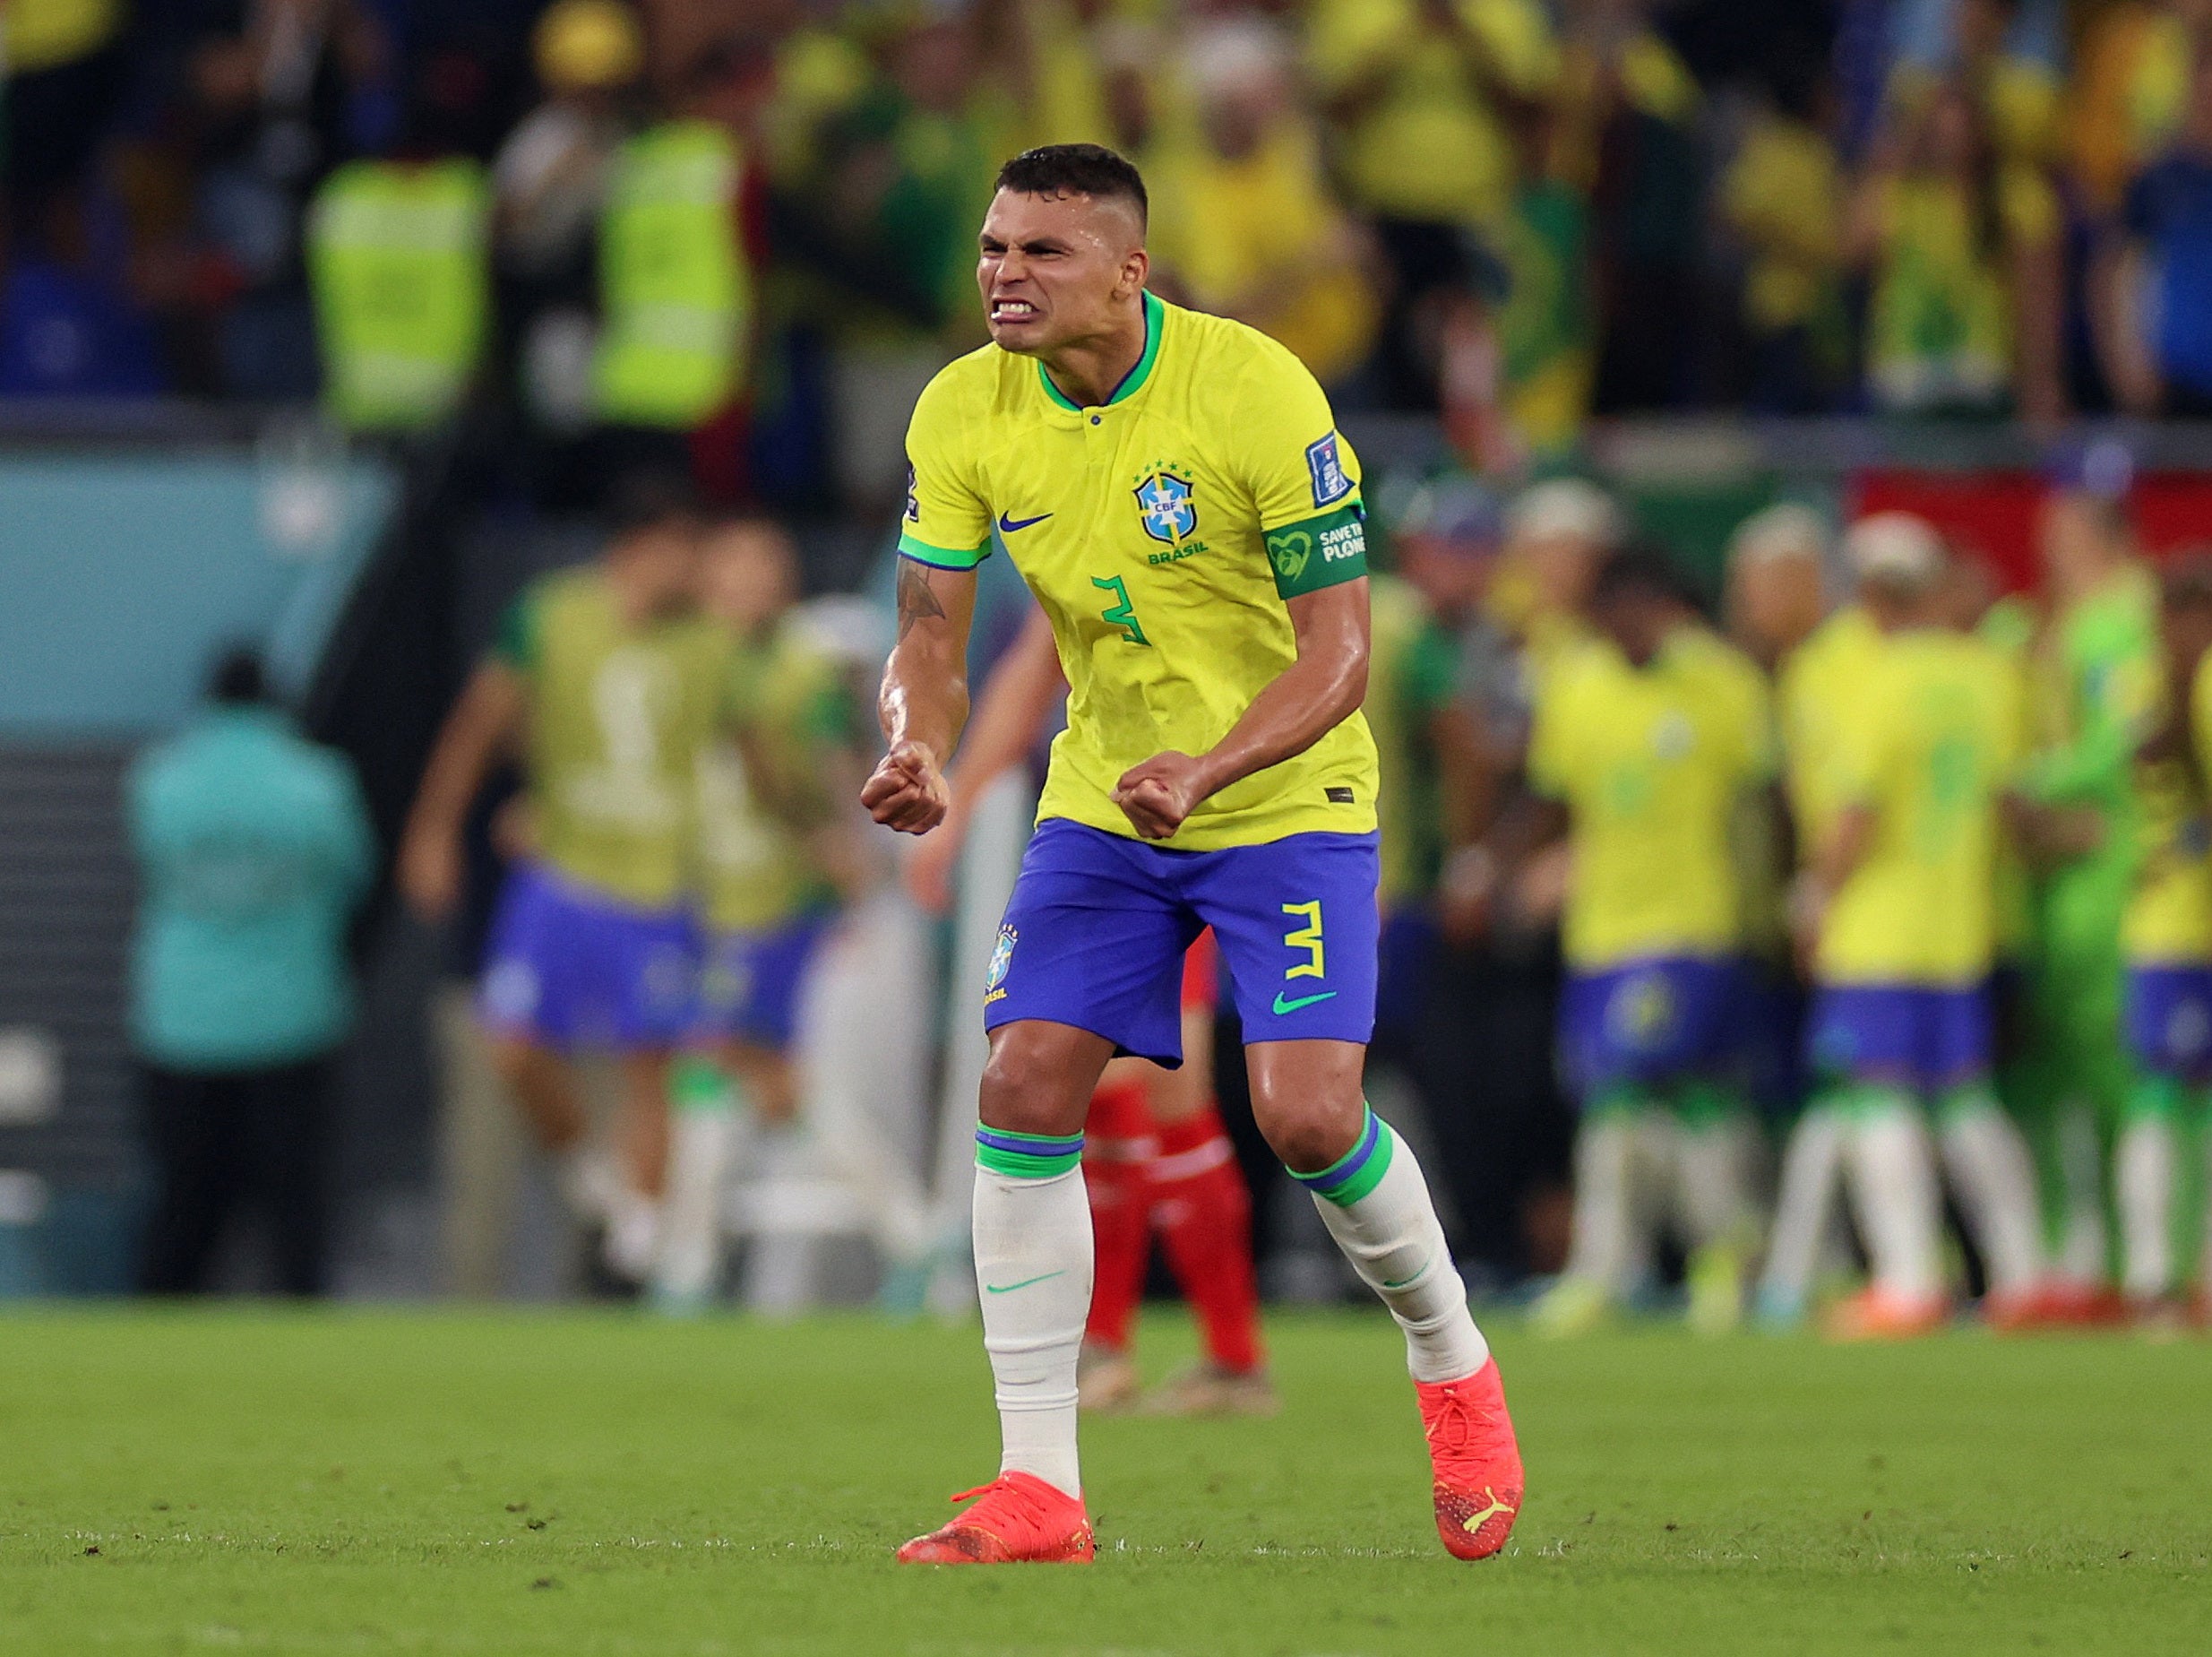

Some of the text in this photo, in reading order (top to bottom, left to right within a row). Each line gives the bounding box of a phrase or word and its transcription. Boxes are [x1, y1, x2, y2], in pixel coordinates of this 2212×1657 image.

[1155, 502, 1176, 513] CBF
[1319, 525, 1352, 547] SAVE
[1148, 541, 1209, 565] BRASIL
[1090, 574, 1152, 647] 3
[1281, 899, 1325, 980] 3
